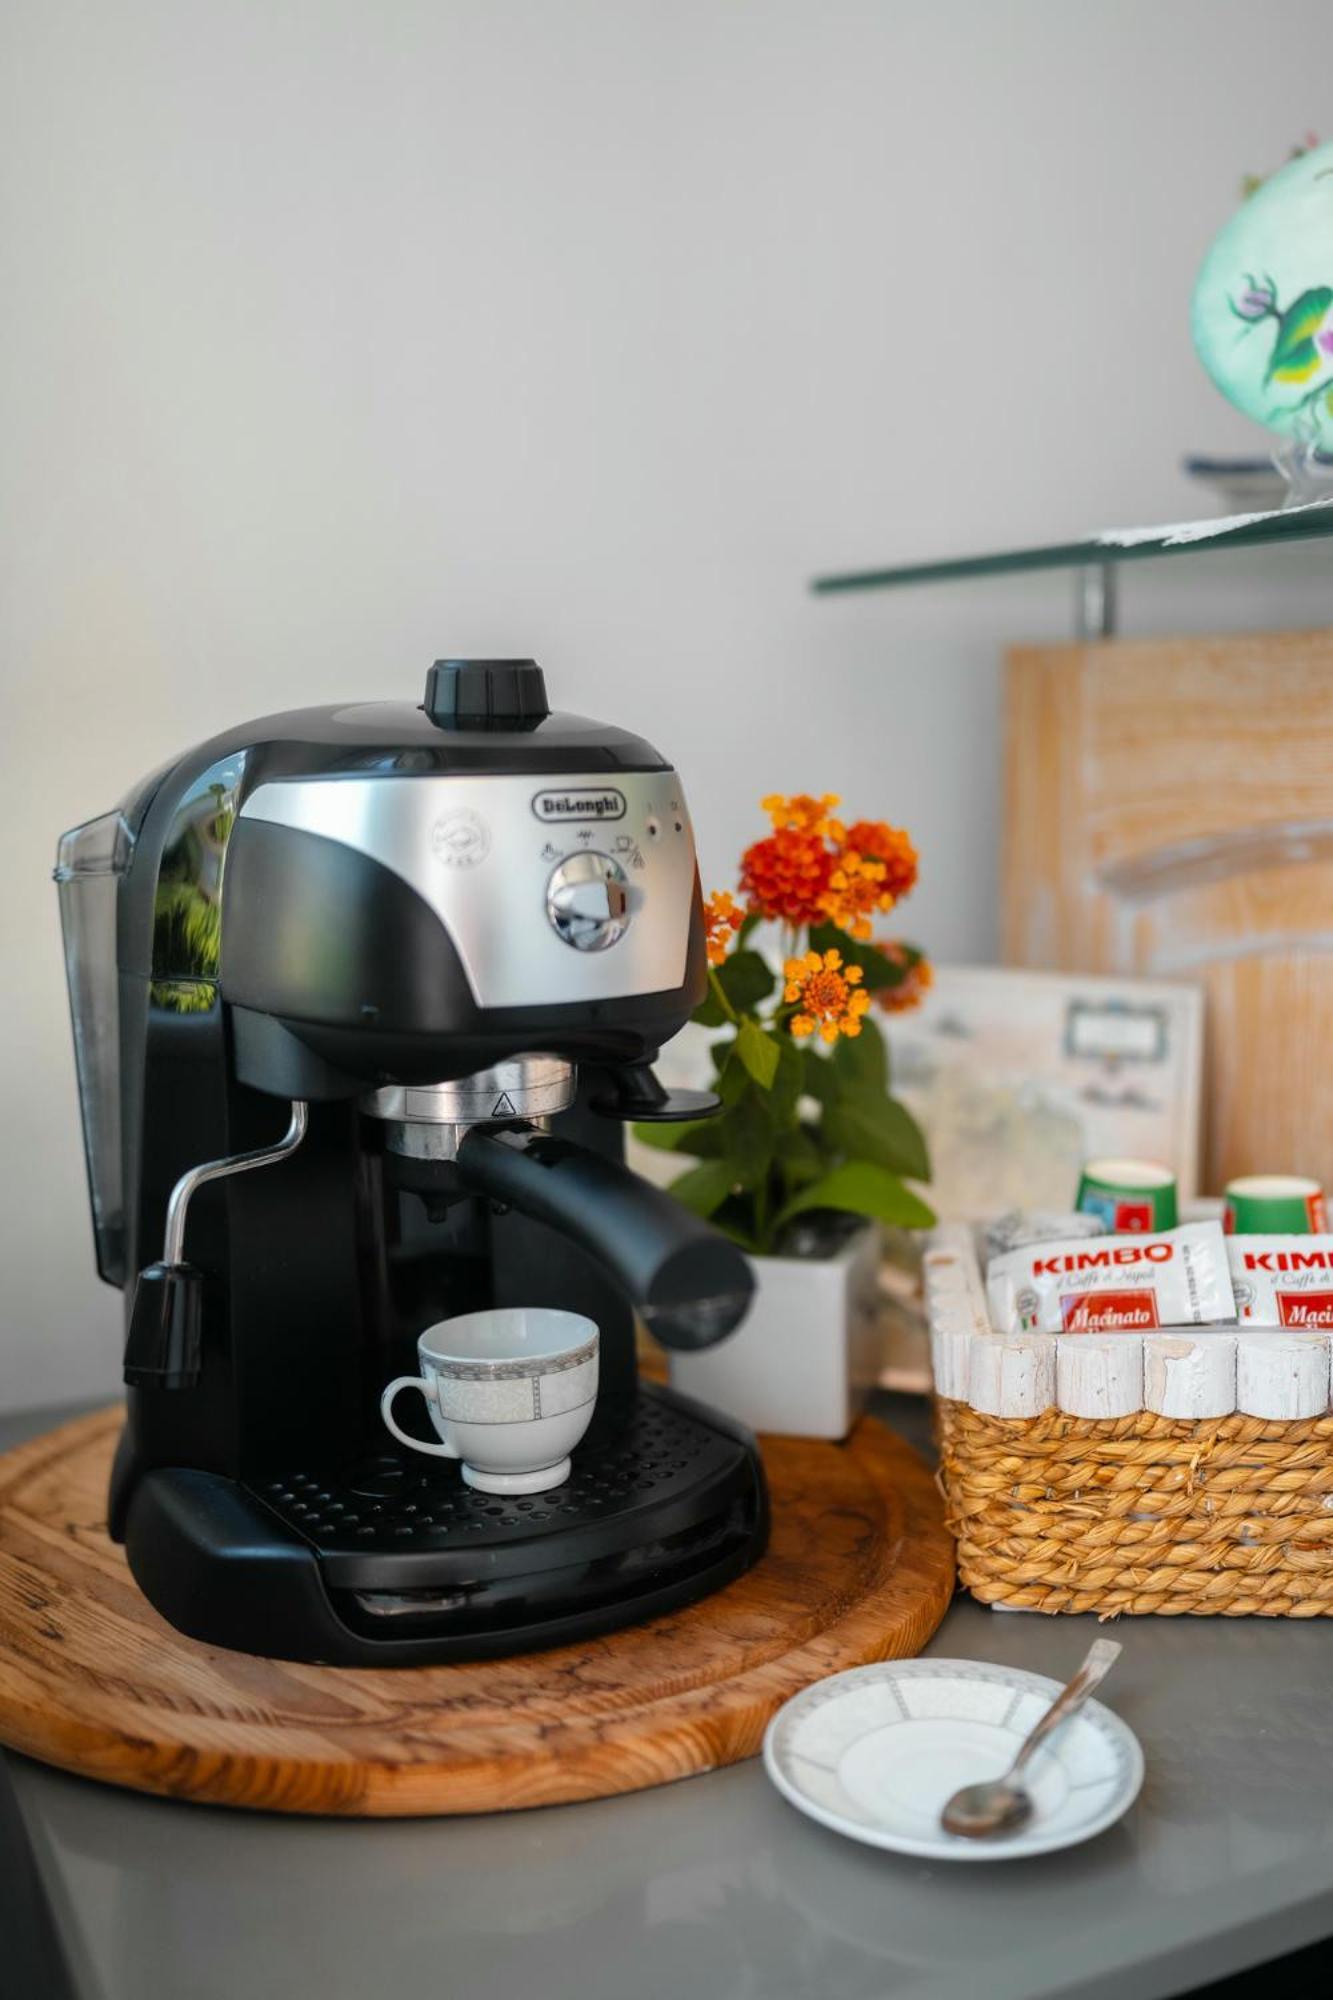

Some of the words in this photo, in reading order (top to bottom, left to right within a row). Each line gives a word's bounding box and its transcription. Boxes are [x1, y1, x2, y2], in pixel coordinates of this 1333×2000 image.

[1033, 1243, 1173, 1277] KIMBO
[1244, 1252, 1333, 1272] KIM
[1070, 1307, 1150, 1331] Macinato
[1288, 1304, 1333, 1324] Maci
